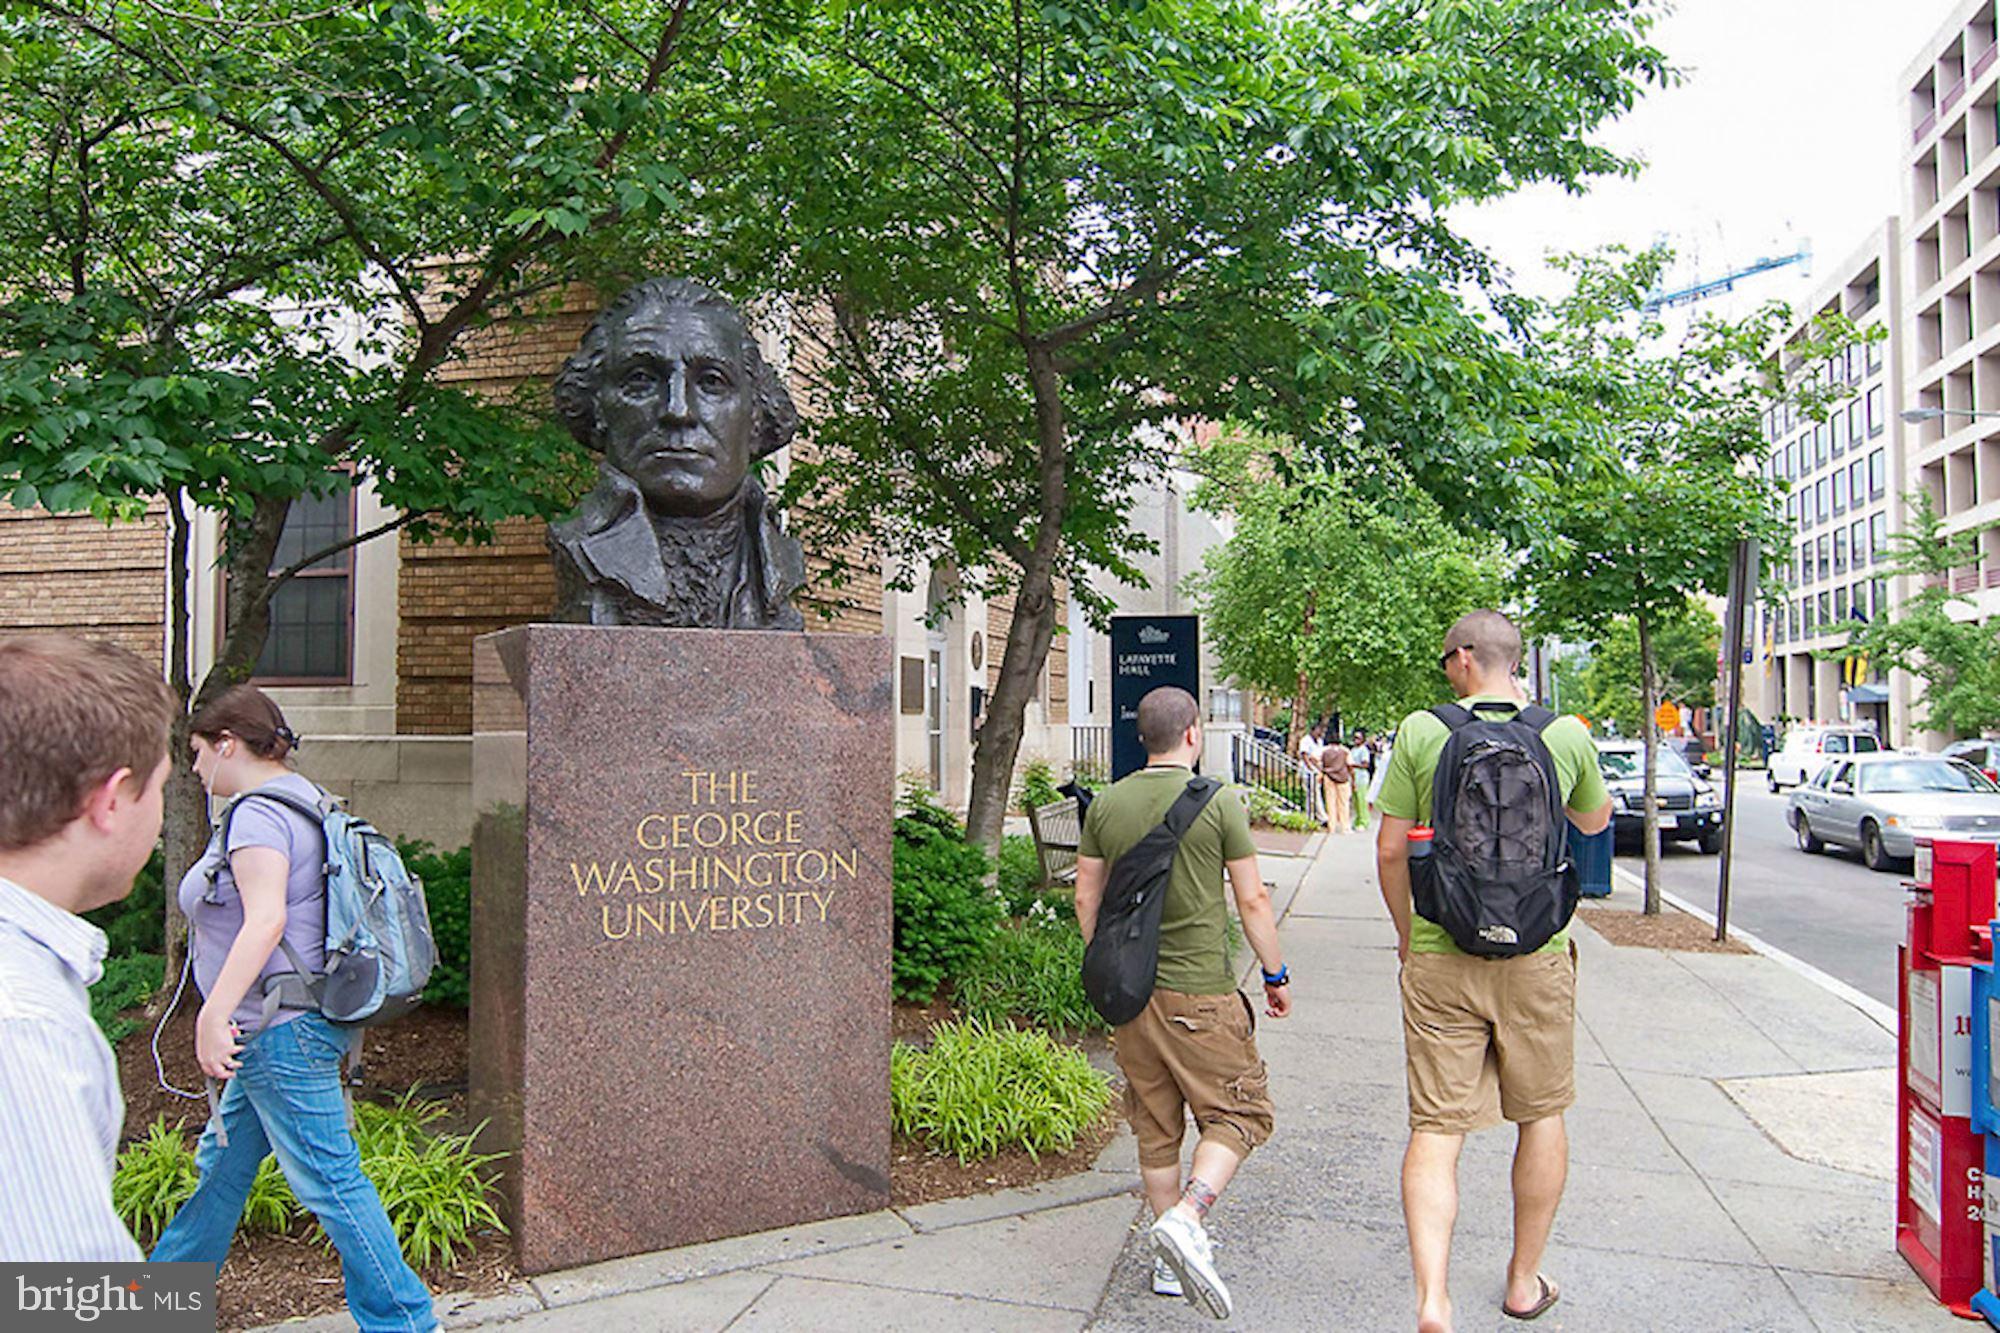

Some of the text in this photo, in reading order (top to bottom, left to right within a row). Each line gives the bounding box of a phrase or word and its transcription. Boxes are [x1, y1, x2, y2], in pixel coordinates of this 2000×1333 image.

[1118, 653, 1176, 665] LAFAYETTE
[681, 770, 758, 805] THE
[637, 810, 802, 850] GEORGE
[570, 848, 858, 897] WASHINGTON
[602, 890, 835, 940] UNIVERSITY
